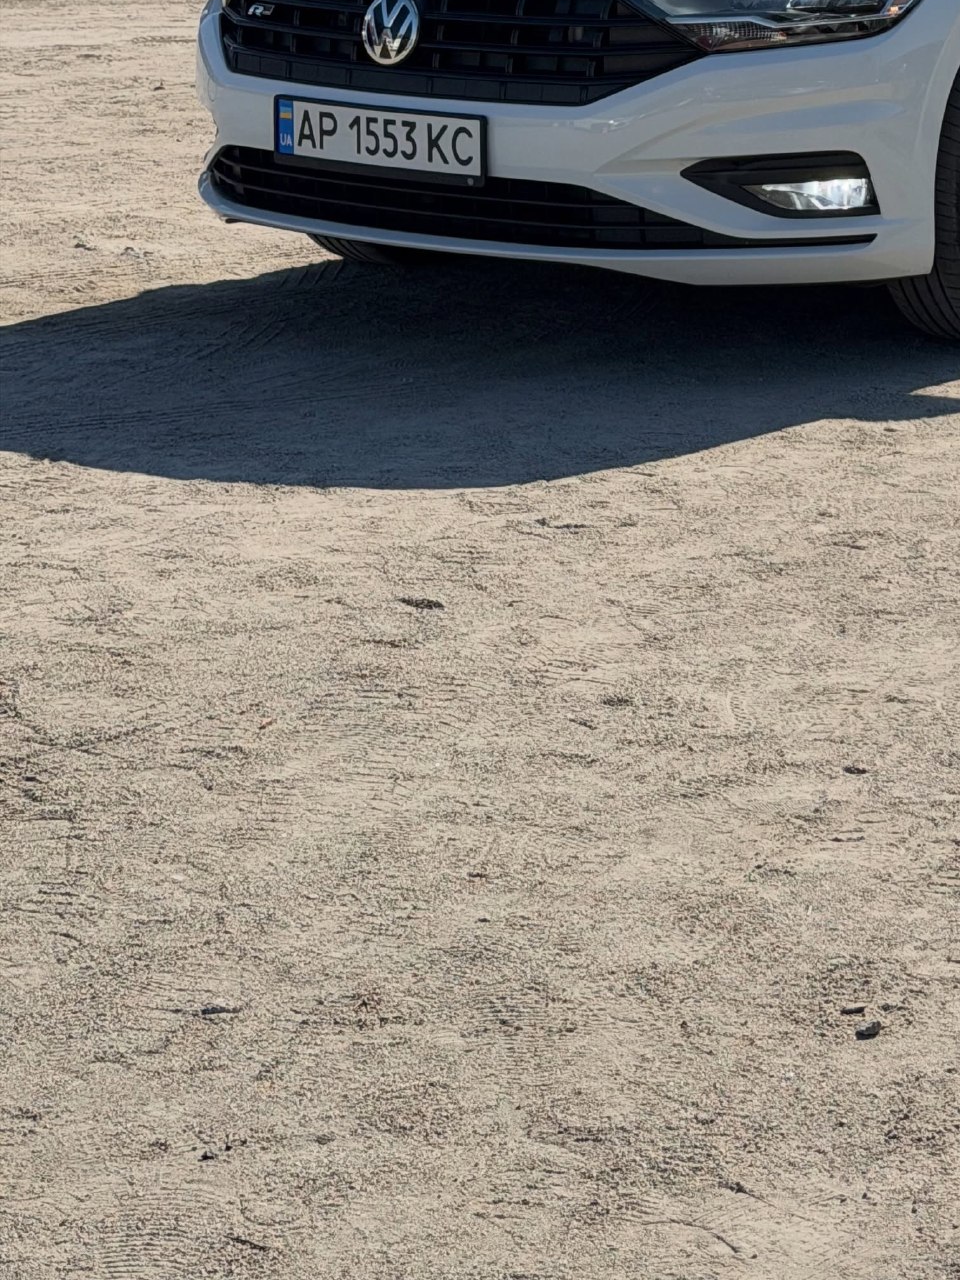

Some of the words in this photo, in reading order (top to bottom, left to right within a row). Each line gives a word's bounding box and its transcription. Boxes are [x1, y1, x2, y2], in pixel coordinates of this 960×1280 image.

[279, 133, 293, 146] UA
[298, 109, 338, 150] AP
[348, 115, 417, 160] 1553
[427, 123, 474, 166] KC
